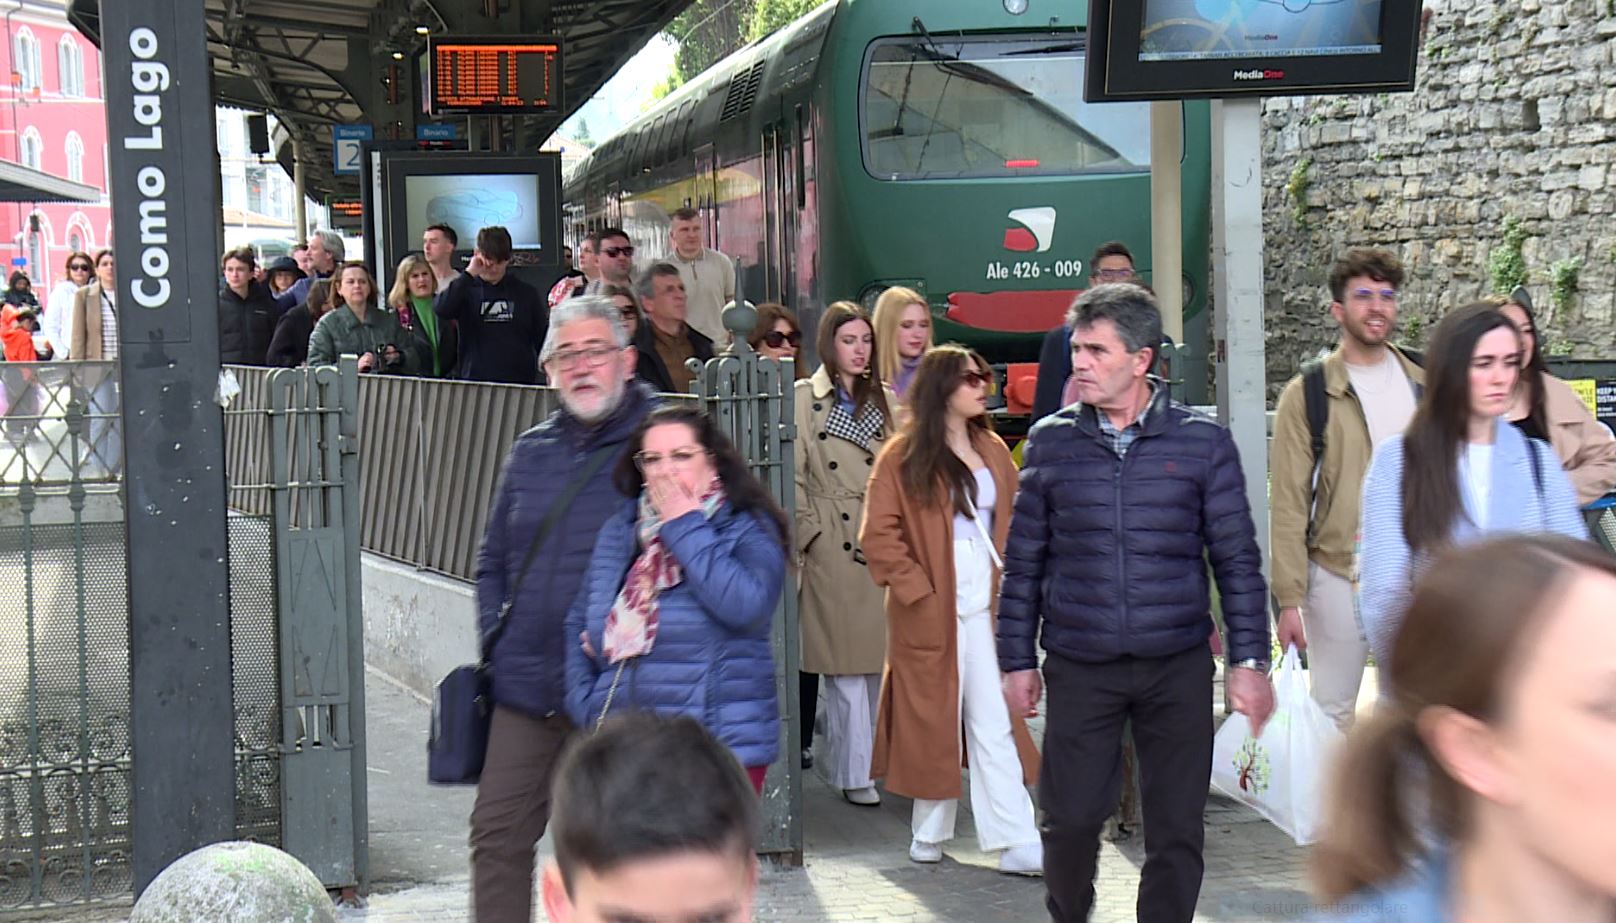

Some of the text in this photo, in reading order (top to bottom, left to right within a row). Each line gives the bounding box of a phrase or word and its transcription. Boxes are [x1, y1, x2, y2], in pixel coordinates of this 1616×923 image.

[1234, 70, 1285, 80] MediaOne
[424, 129, 448, 137] Binario
[346, 143, 360, 167] 2
[124, 27, 171, 309] Como Lago
[986, 262, 1008, 279] Ale
[1013, 261, 1040, 278] 426
[1055, 260, 1082, 277] 009
